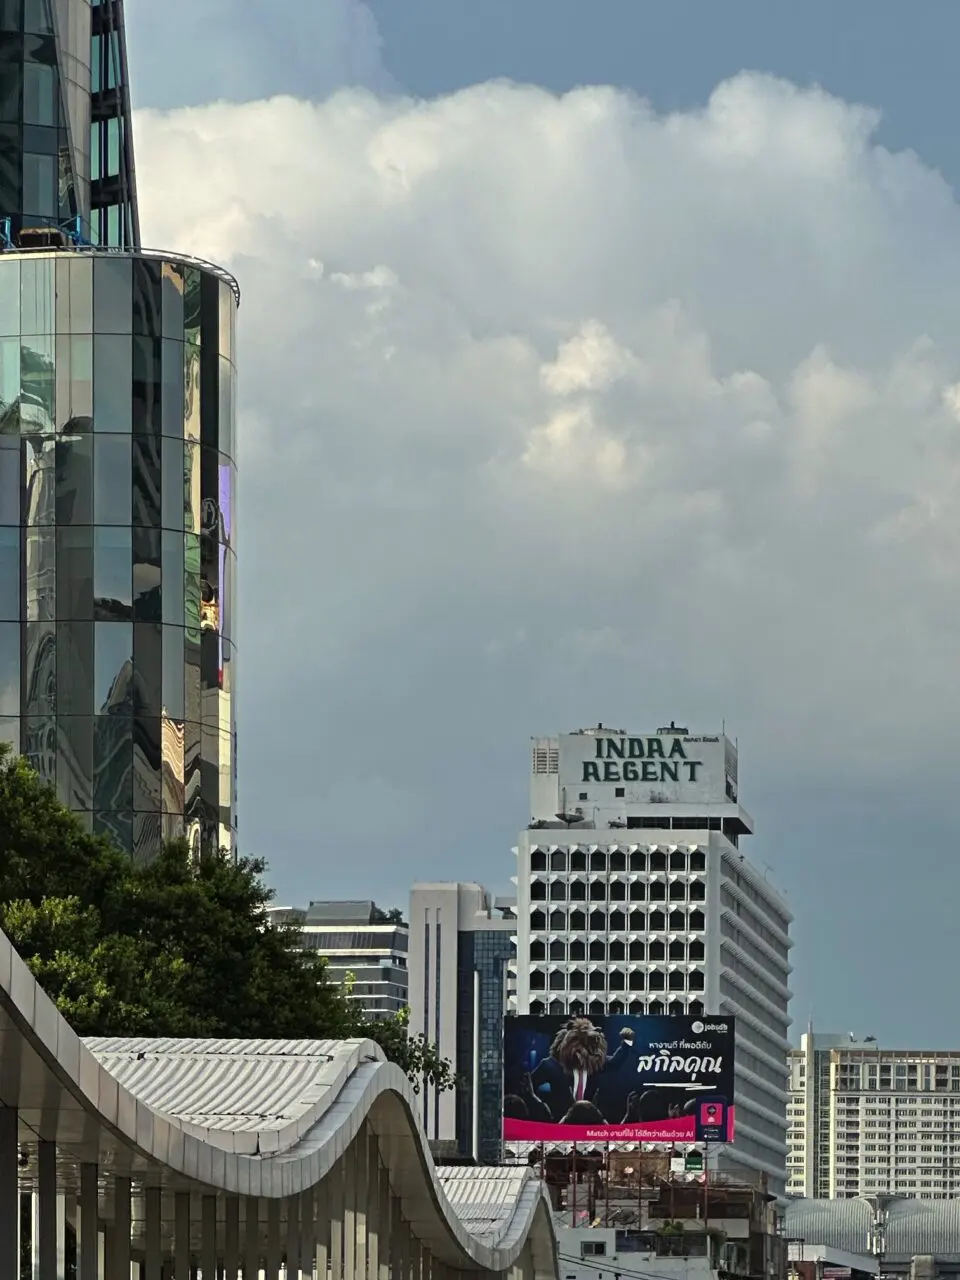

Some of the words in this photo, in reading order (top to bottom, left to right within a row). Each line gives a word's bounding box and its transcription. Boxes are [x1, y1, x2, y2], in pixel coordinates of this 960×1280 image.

[595, 738, 687, 759] INDRA
[582, 761, 703, 782] REGENT
[637, 1049, 722, 1081] สกิลคุณ
